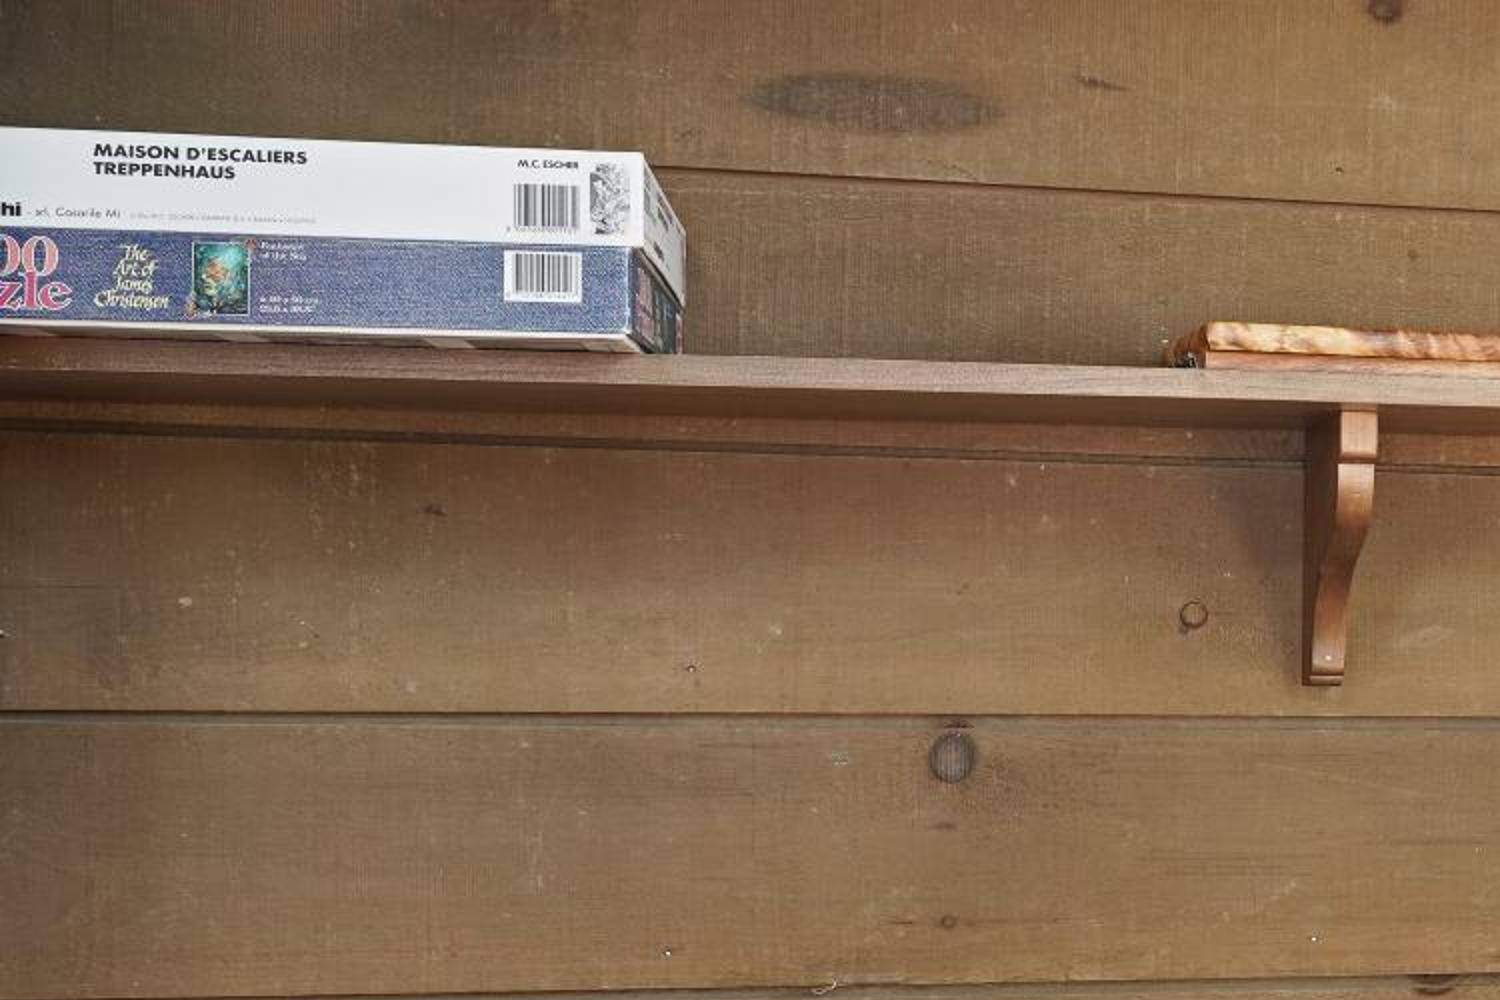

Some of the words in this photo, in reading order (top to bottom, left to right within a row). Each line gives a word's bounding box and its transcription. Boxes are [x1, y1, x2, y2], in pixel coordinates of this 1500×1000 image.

[93, 143, 179, 160] MAISON
[186, 146, 308, 165] D'ESCALIERS
[93, 161, 237, 180] TREPPENHAUS
[121, 243, 150, 262] The
[93, 291, 170, 310] Christensen
